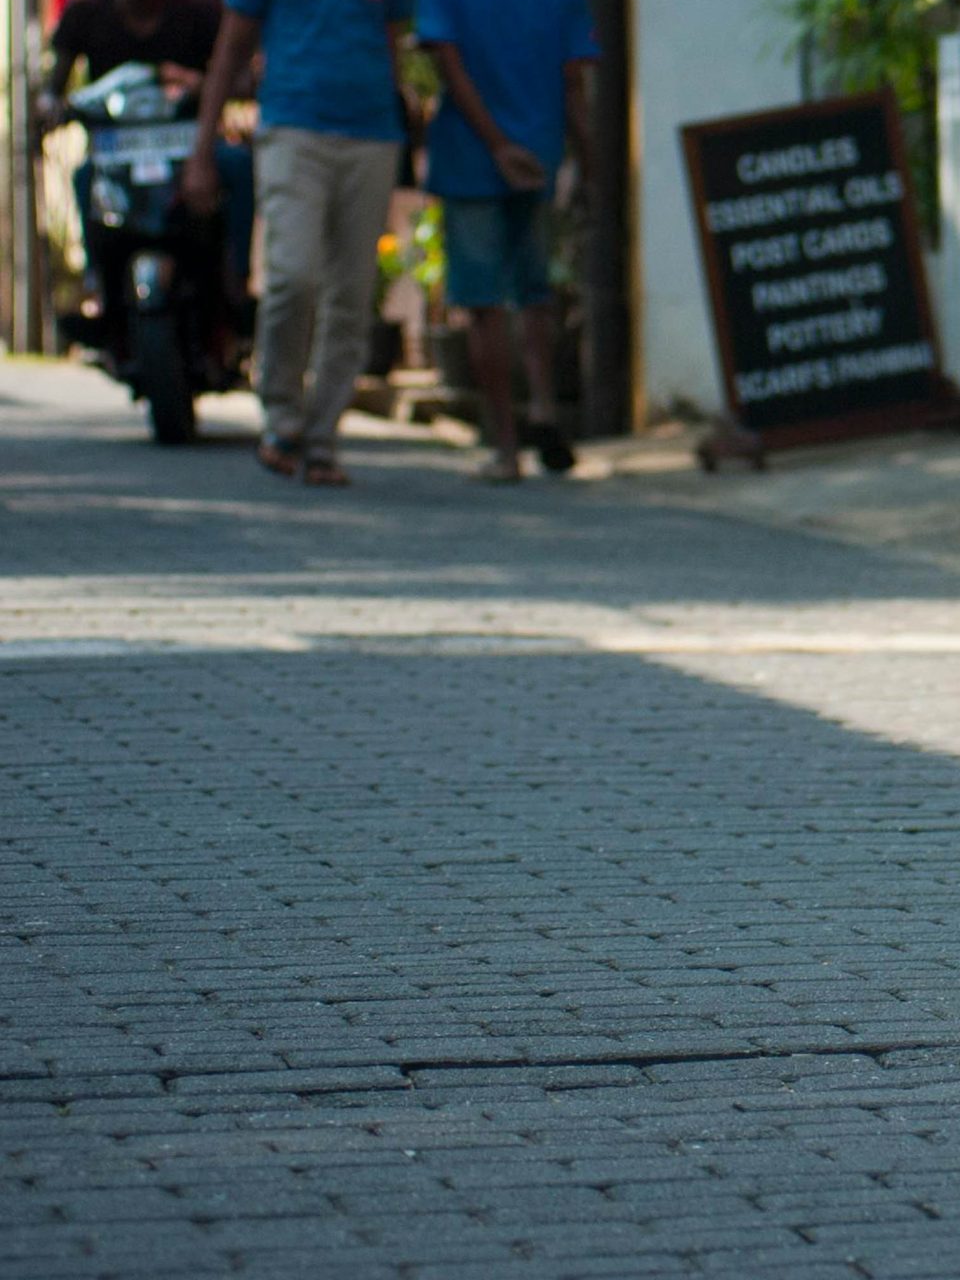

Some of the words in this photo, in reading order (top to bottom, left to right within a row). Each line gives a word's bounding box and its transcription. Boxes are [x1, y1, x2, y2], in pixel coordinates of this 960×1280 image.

[737, 136, 858, 183] CANDLES
[845, 171, 904, 208] OILS
[730, 232, 798, 272] POST
[802, 218, 892, 260] CARDS
